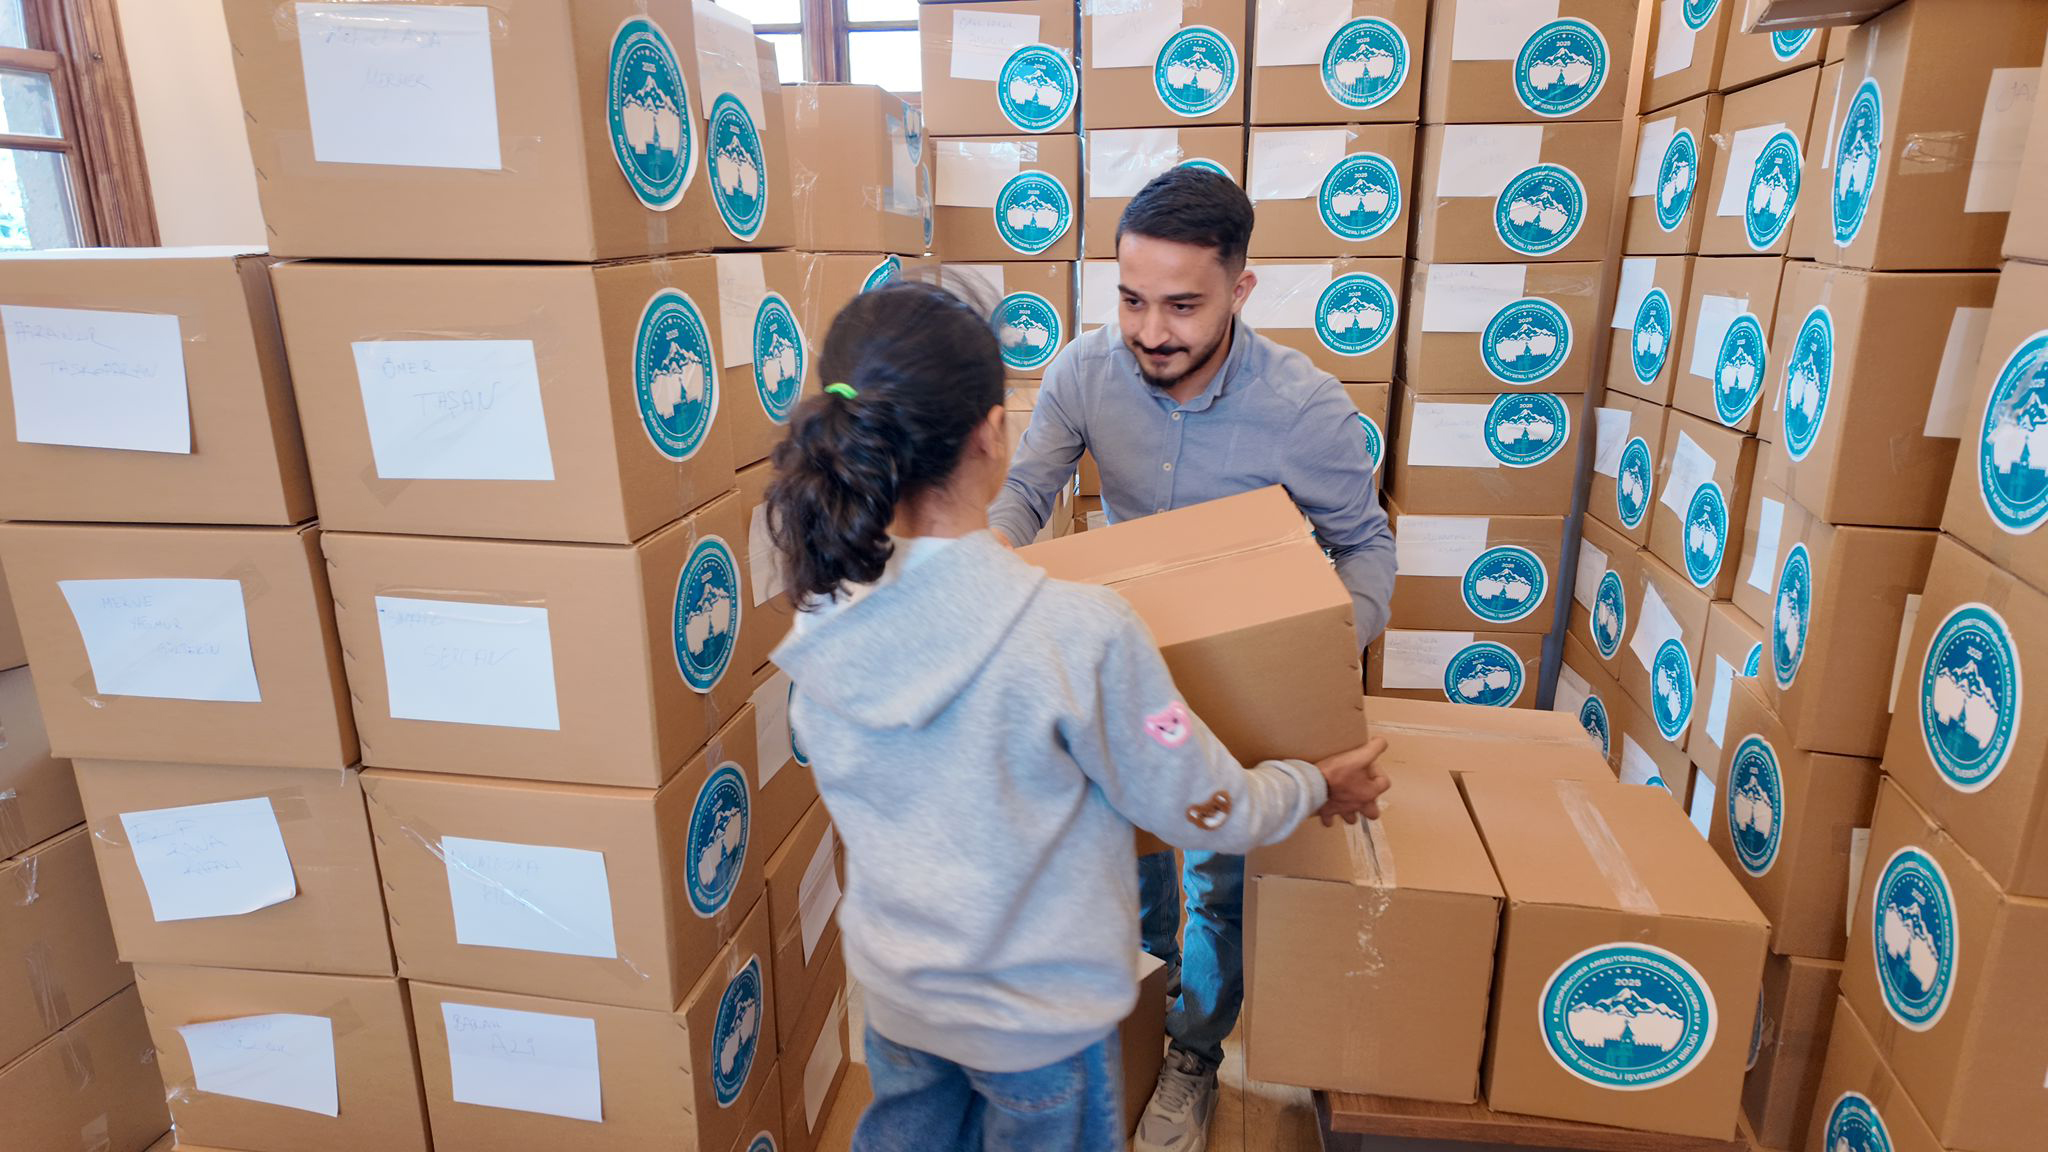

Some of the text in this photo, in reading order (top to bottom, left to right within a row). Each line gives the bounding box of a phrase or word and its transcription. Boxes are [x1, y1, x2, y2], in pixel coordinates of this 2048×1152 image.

[1356, 36, 1370, 44] 2025
[1354, 171, 1368, 179] 2025
[1540, 184, 1556, 192] 2025
[1518, 316, 1533, 324] 2025
[382, 357, 437, 379] ÖMER
[1614, 978, 1642, 987] 2025
[1680, 980, 1700, 1011] KAYSERI
[1554, 1029, 1580, 1061] AVRUPA
